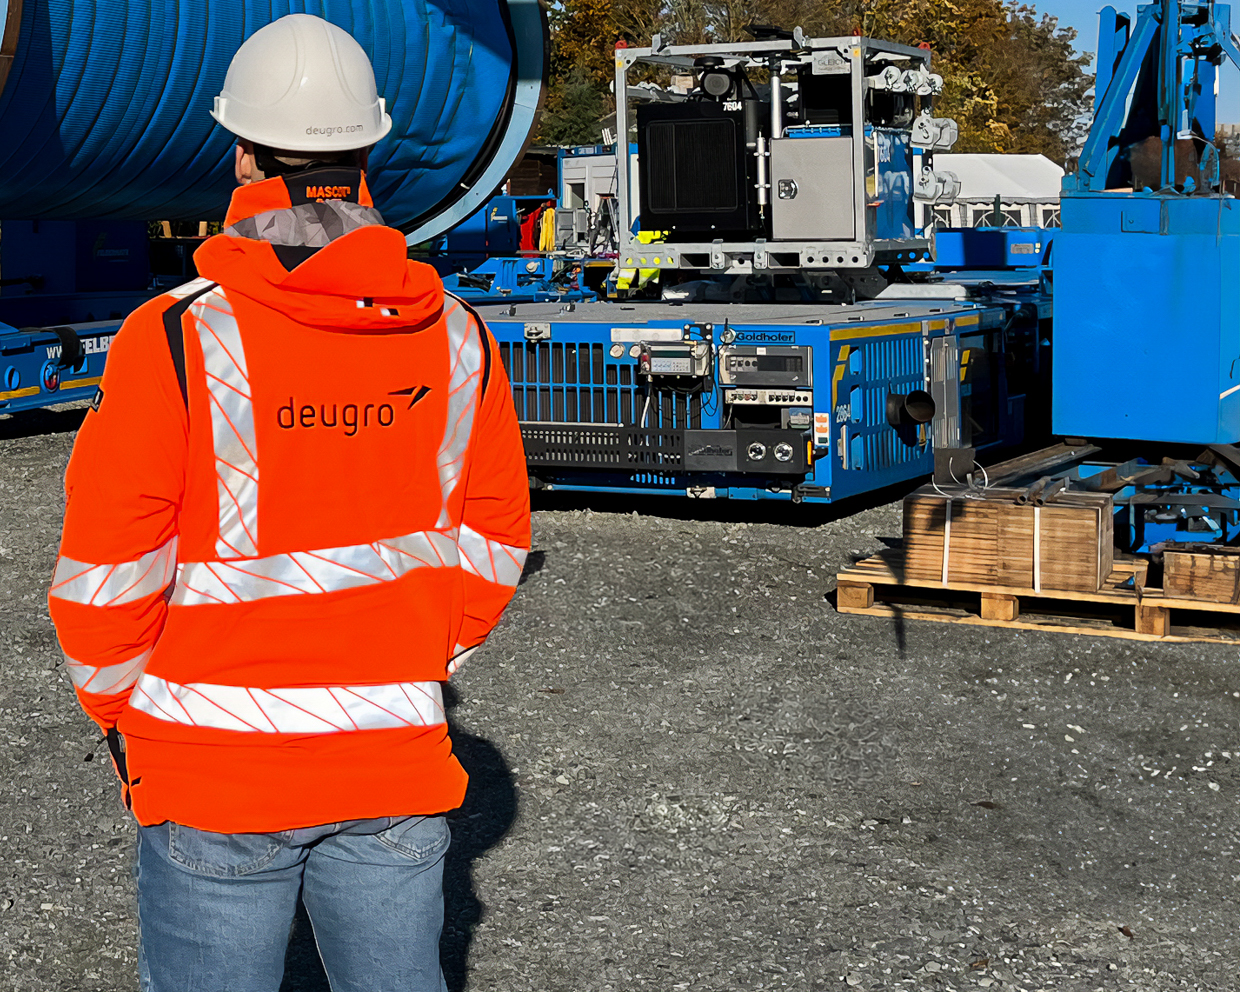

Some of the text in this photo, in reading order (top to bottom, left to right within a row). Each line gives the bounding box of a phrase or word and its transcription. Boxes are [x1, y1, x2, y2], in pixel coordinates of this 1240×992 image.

[305, 124, 364, 137] deugro.com
[736, 332, 793, 341] Goldhofer
[277, 396, 394, 436] deugro
